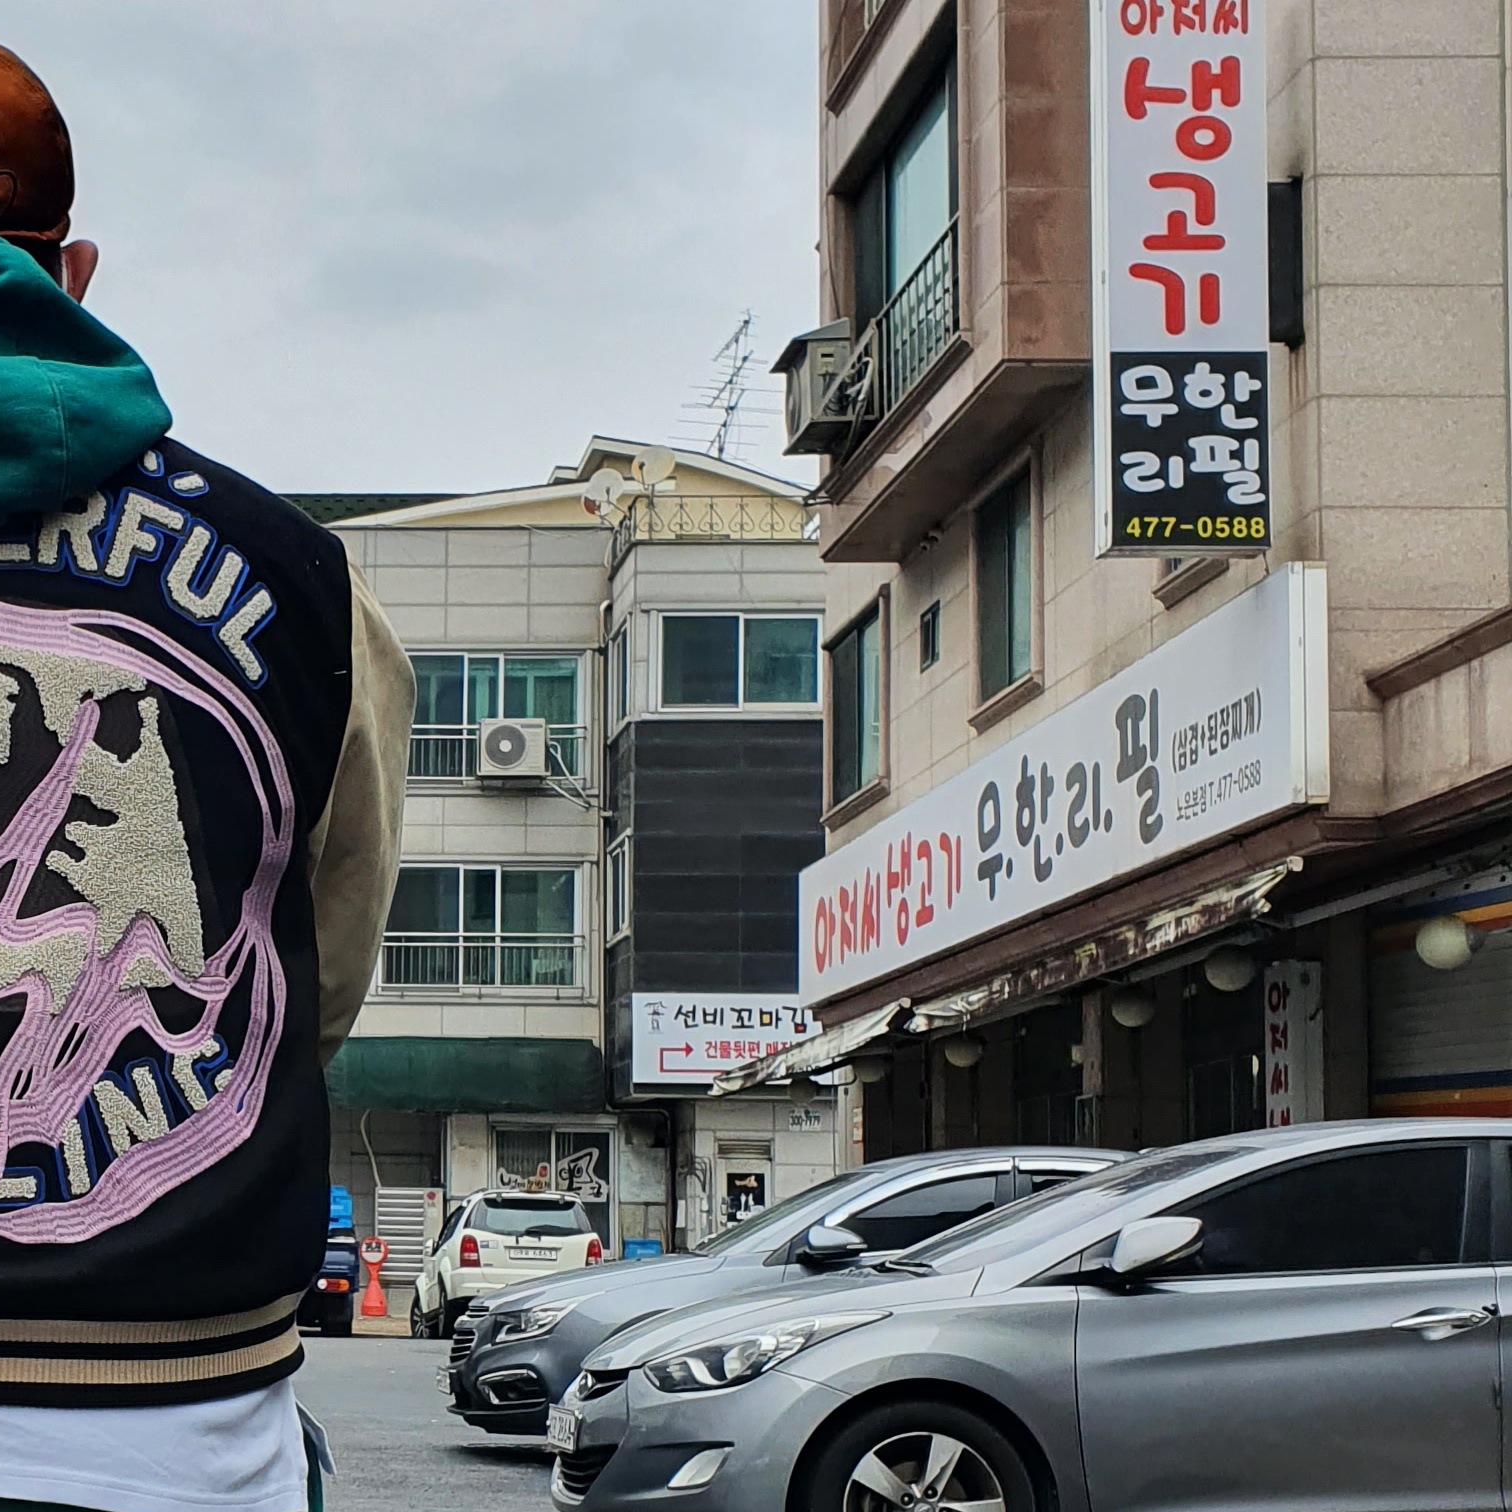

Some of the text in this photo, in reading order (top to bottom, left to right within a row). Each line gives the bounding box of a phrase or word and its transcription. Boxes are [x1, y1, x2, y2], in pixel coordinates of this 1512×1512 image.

[1120, 361, 1262, 430] 무한
[1120, 434, 1266, 505] 리필
[1125, 516, 1266, 539] 477-0588
